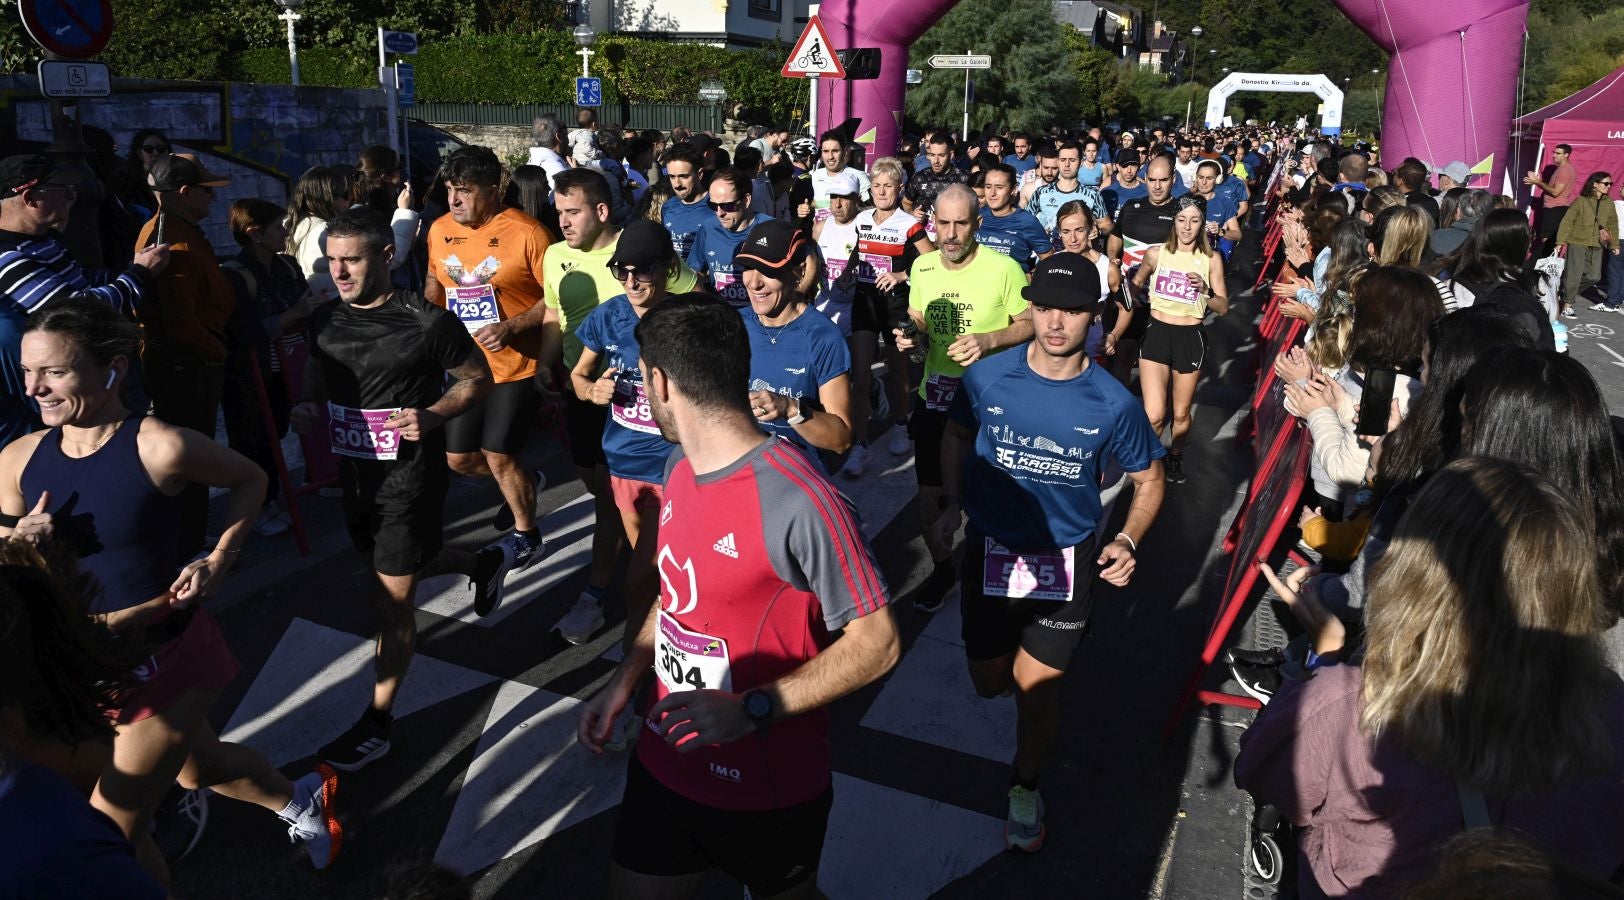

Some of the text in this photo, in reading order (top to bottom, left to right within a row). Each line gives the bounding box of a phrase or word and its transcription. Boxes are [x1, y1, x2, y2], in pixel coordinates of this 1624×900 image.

[1160, 280, 1196, 298] 1042
[452, 302, 493, 318] 1292
[334, 428, 394, 448] 3083
[1017, 458, 1082, 474] KROSSA
[1017, 465, 1042, 474] CROSS
[713, 543, 738, 558] adidas
[666, 641, 687, 661] JONPE
[680, 640, 699, 650] kutxa
[661, 643, 706, 690] 304
[710, 762, 740, 778] IMQ
